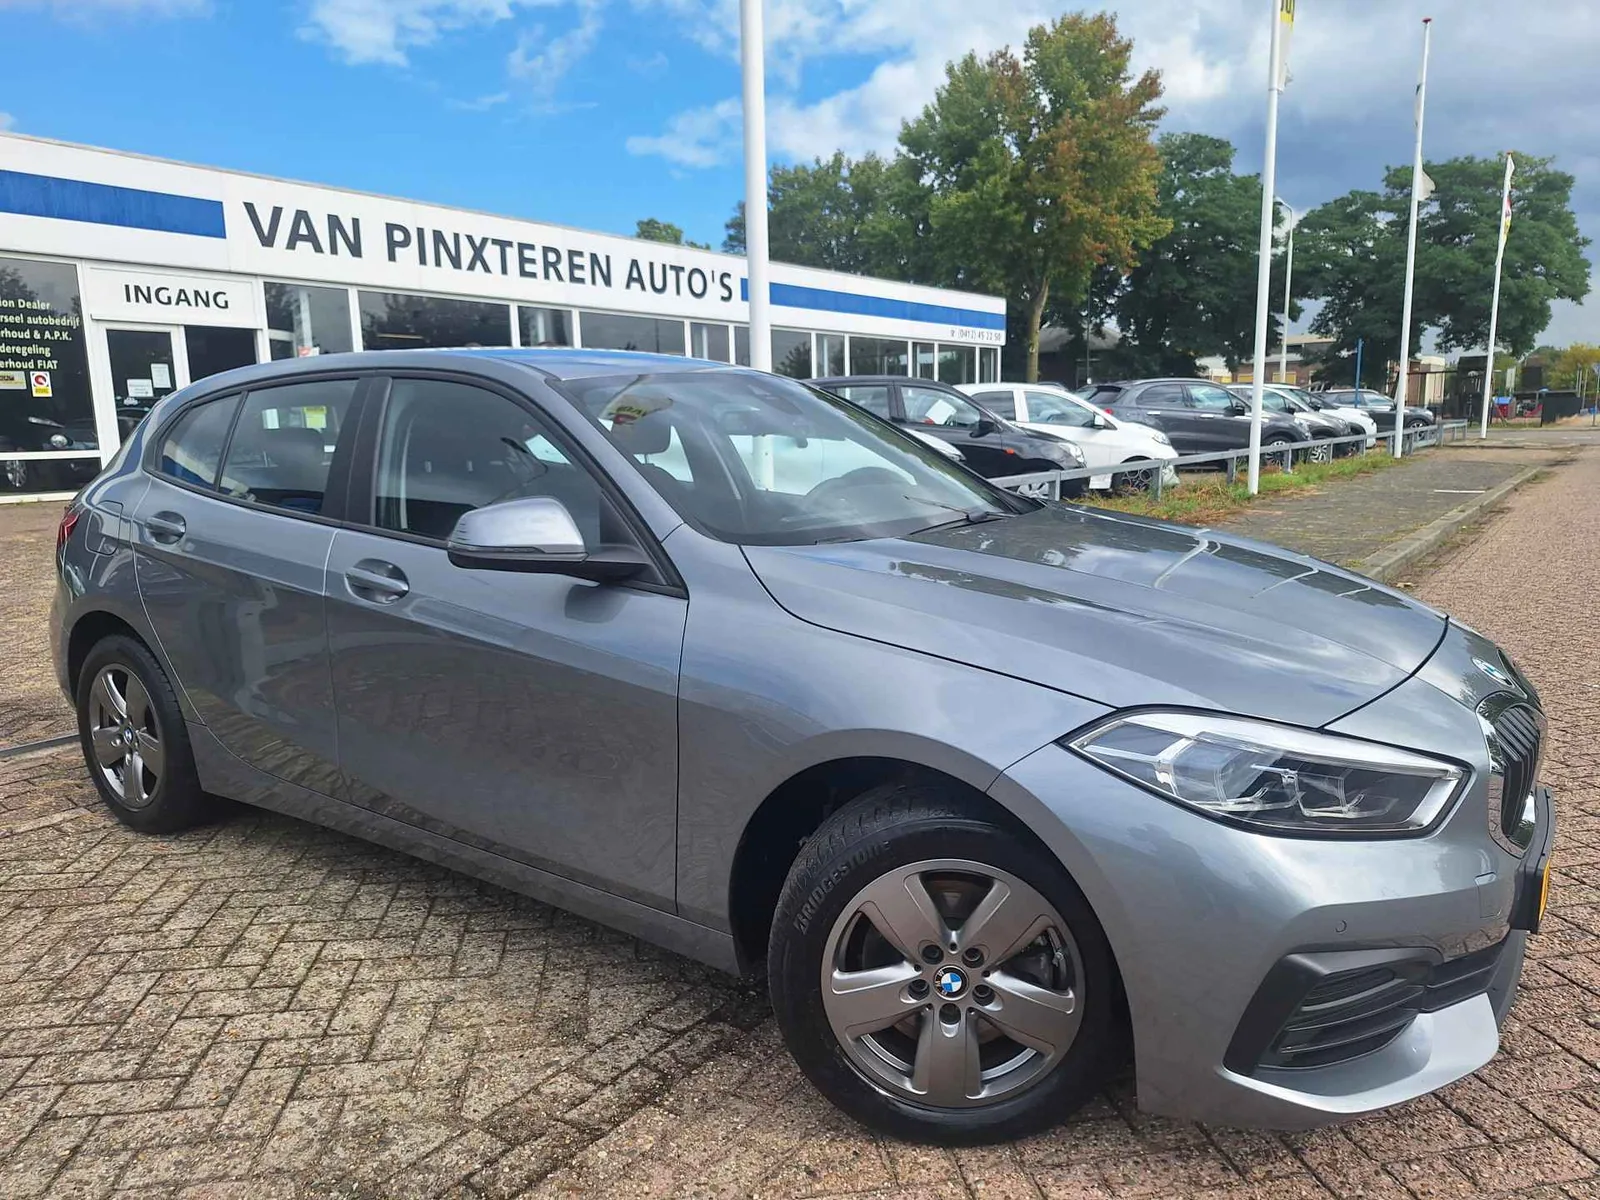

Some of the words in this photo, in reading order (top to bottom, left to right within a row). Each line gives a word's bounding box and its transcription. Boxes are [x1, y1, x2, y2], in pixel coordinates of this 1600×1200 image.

[243, 201, 363, 258] VAN
[385, 222, 613, 288] PINXTEREN
[625, 258, 733, 302] AUTO'S
[124, 284, 230, 309] INGANG
[18, 298, 51, 310] Dealer
[27, 315, 80, 329] autobedrijf
[33, 330, 41, 340] &
[44, 331, 72, 341] A.P.K.
[37, 359, 58, 370] FIAT
